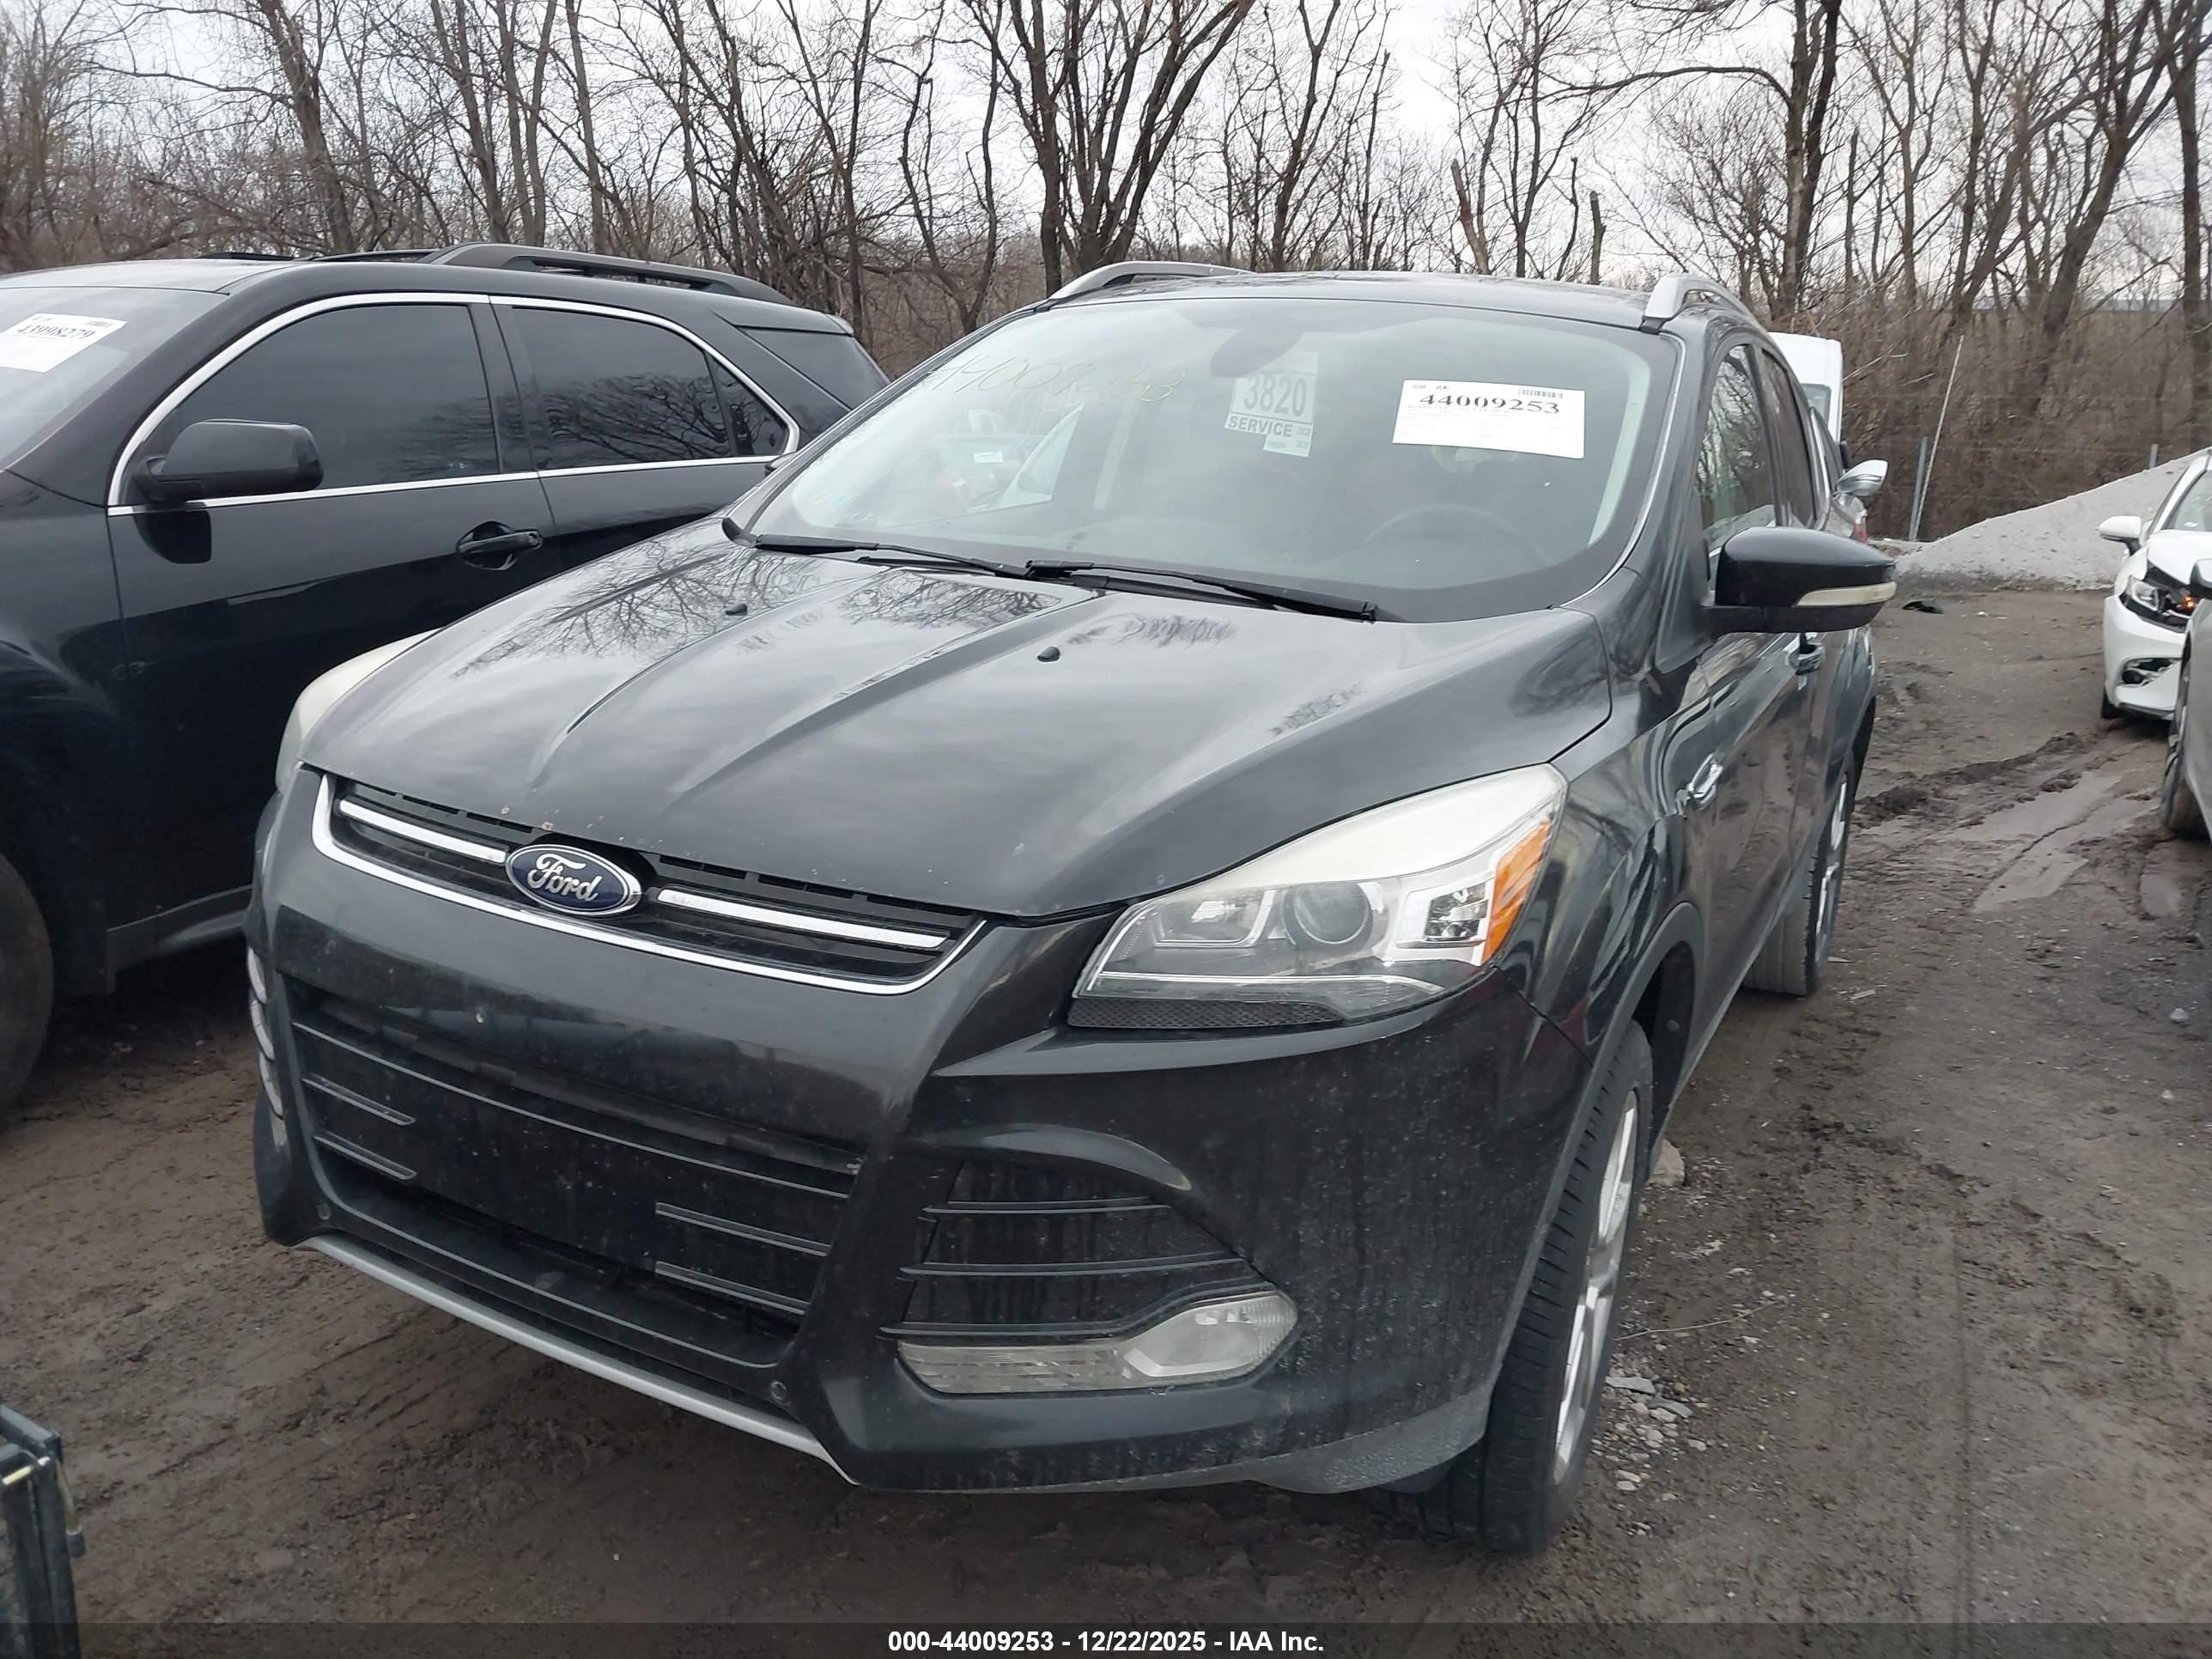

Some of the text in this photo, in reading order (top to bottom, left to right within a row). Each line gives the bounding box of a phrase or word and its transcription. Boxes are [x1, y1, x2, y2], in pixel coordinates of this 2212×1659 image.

[1243, 374, 1307, 417] 3820
[1419, 393, 1561, 415] 44009253
[1228, 416, 1294, 438] SERVICE
[527, 853, 603, 902] Ford
